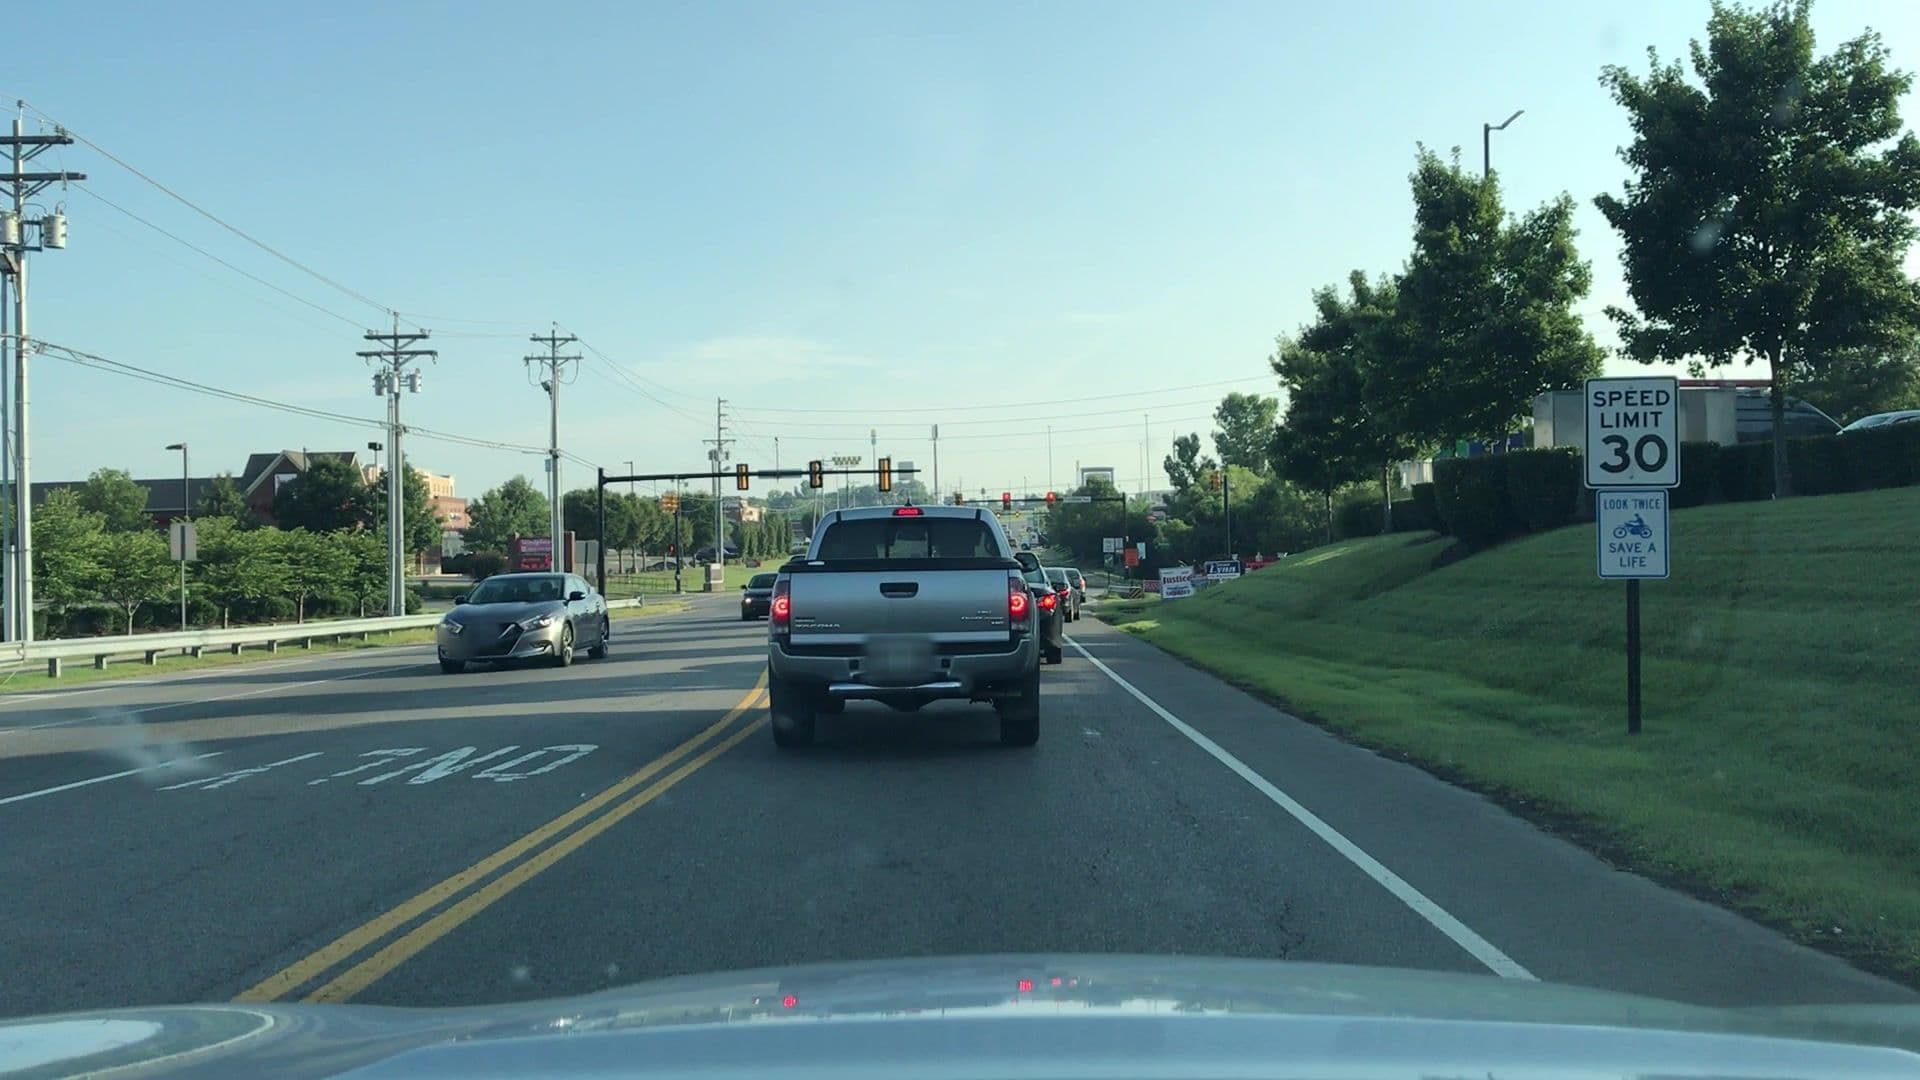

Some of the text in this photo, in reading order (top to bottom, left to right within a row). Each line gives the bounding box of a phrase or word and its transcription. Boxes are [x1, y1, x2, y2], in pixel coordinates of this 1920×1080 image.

[1593, 390, 1670, 407] SPEED
[1600, 411, 1662, 428] LIMIT
[1600, 434, 1668, 473] 30
[1604, 498, 1660, 510] LOOK TWICE
[1609, 542, 1656, 553] SAVE A
[1619, 556, 1646, 568] LIFE
